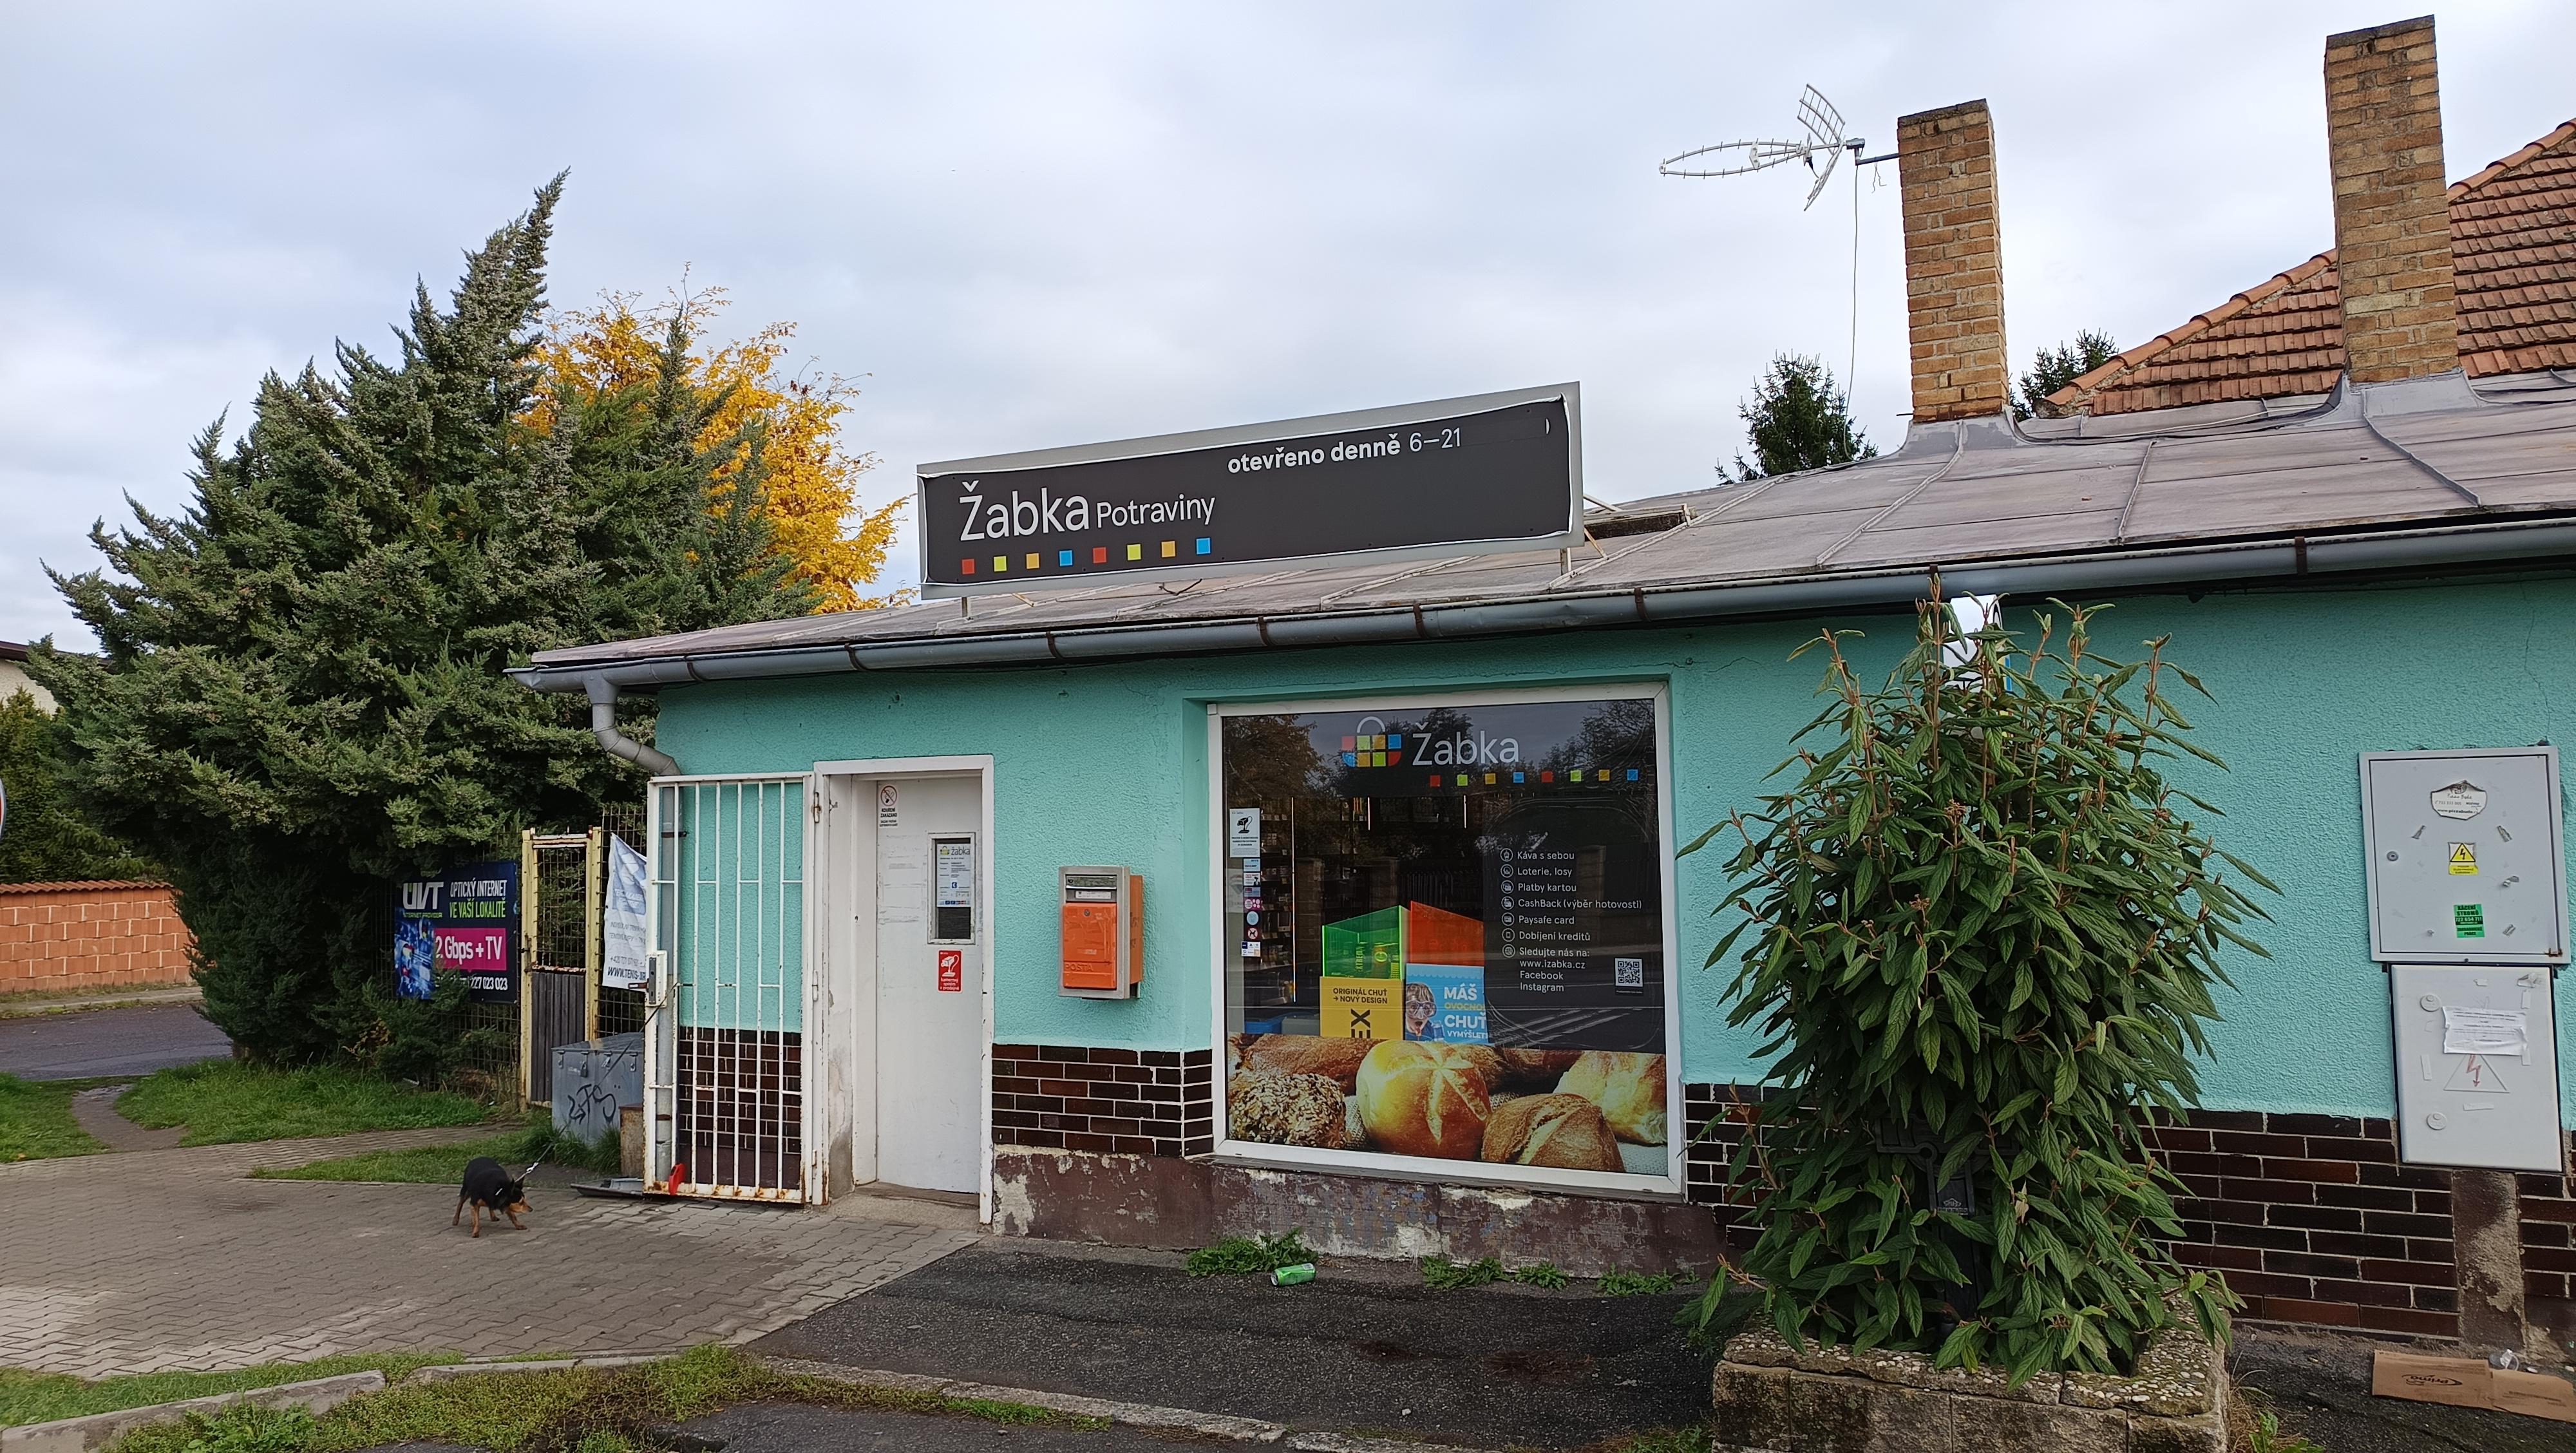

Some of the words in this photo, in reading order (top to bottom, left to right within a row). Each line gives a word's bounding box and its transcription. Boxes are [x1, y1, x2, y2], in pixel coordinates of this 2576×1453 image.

[1227, 446, 1325, 473] otevřeno
[1331, 432, 1401, 462] denně
[959, 480, 1090, 541] Žabka
[1097, 493, 1215, 528] Potraviny
[1412, 721, 1519, 766] Žabka
[1517, 851, 1537, 860] Káva
[1547, 851, 1575, 860] sebou
[1517, 867, 1552, 876] Loterie,
[1555, 868, 1572, 877] losy
[450, 877, 476, 898] OPTICKÝ
[477, 879, 507, 897] INTERNET
[1518, 882, 1544, 893] Platby
[1547, 883, 1577, 892] kartou
[450, 902, 457, 918] VE
[459, 898, 474, 918] VAŠÍ
[475, 897, 506, 918] LOKALITĚ
[1518, 898, 1562, 907] CashBack
[1564, 899, 1593, 909] (výběr
[1595, 899, 1642, 909] hotovosti)
[1519, 915, 1551, 926] Paysafe
[1554, 916, 1575, 924] card
[1519, 931, 1556, 942] Dobíjení
[1558, 932, 1591, 941] kreditů
[435, 936, 443, 958] 2
[444, 935, 473, 965] Gbps
[475, 942, 484, 958] +
[485, 936, 502, 960] TV
[1519, 947, 1556, 958] Sledujte
[1558, 948, 1573, 956] nás
[1520, 960, 1586, 969] www.izabka.cz
[1520, 970, 1564, 980] Facebook
[482, 977, 494, 990] 023
[495, 977, 508, 991] 023
[1520, 982, 1564, 992] Instagram
[1333, 987, 1367, 996] ORIGINÁL
[1368, 988, 1388, 996] CHUŤ
[1444, 983, 1477, 1001] MÁŠ
[1340, 994, 1359, 1003] NOVÝ
[1444, 1012, 1486, 1029] CHUŤ
